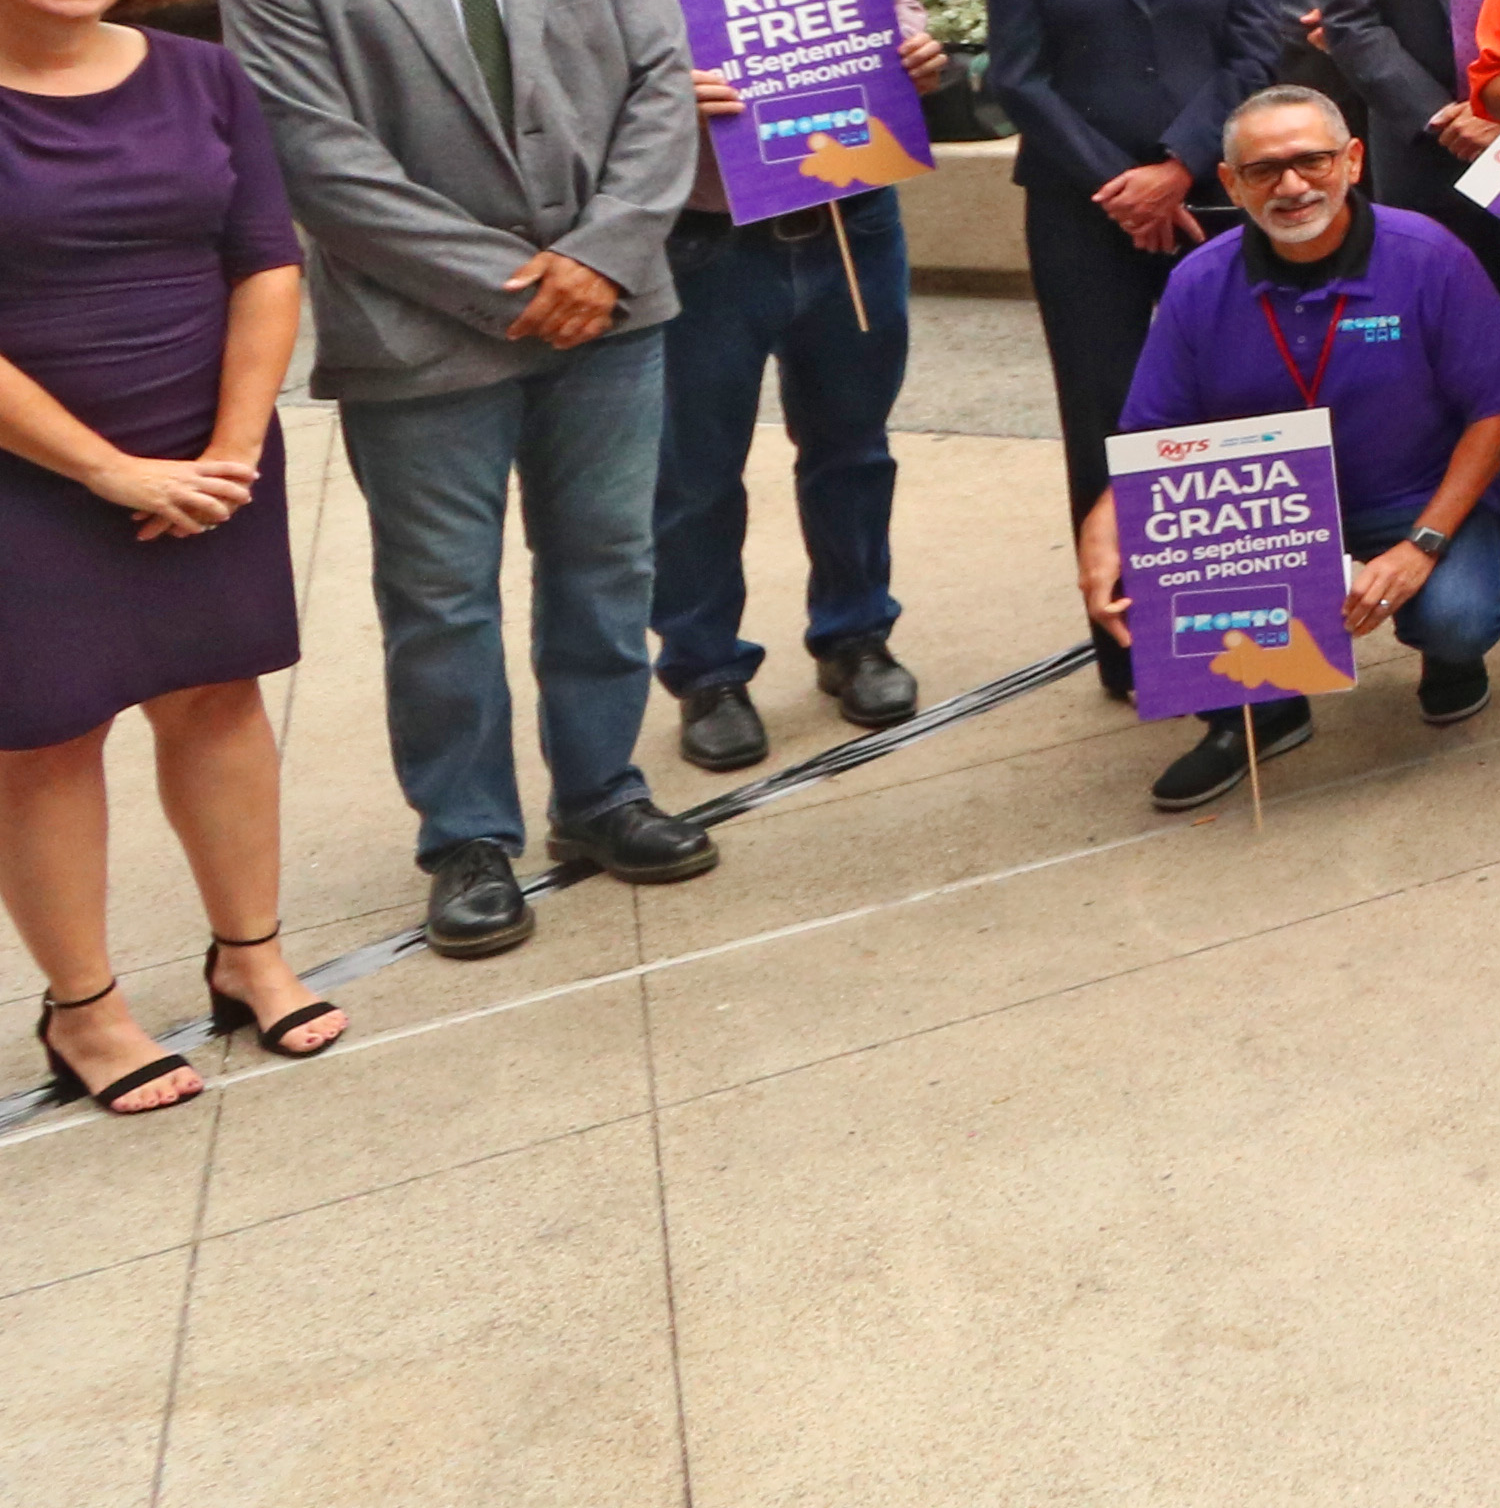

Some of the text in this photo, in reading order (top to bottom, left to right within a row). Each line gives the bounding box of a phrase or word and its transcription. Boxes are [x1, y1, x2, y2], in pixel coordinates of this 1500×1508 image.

[744, 29, 894, 76] September
[786, 54, 882, 89] PRONTO!
[1151, 460, 1299, 512] ¡VIAJA
[1145, 493, 1311, 542] GRATIS
[1130, 528, 1330, 569] todo septiembre
[1158, 551, 1308, 587] con PRONTO!
[1175, 608, 1288, 633] PRONTO
